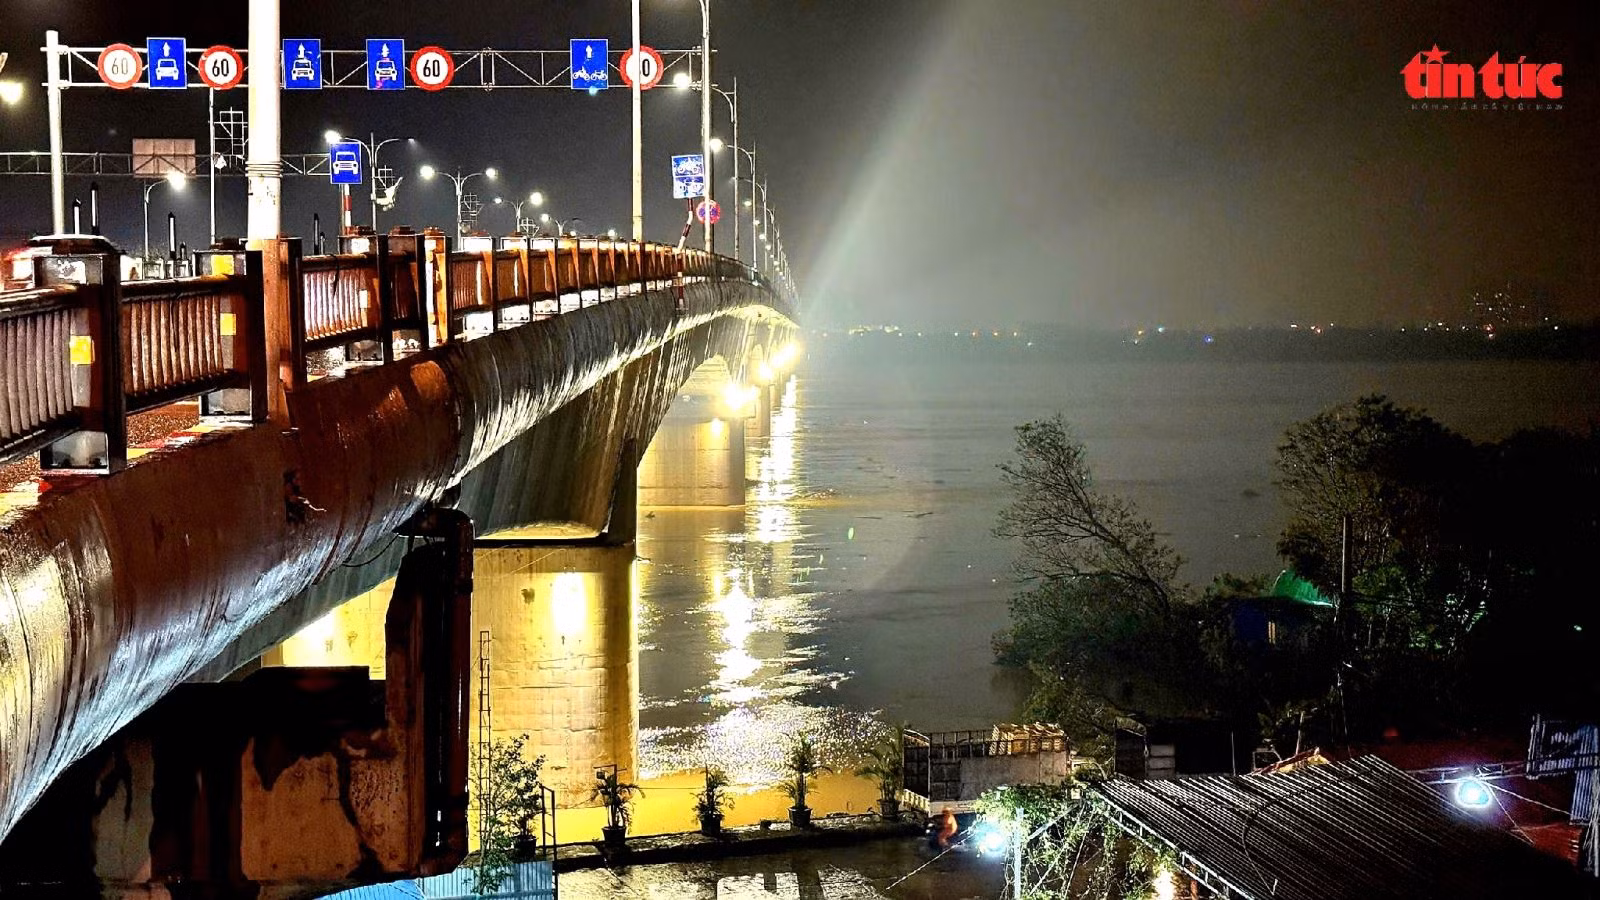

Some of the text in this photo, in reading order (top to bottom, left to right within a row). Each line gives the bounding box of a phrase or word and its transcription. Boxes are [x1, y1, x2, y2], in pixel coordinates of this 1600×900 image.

[112, 57, 128, 75] 60
[212, 58, 230, 77] 60
[423, 59, 440, 77] 60
